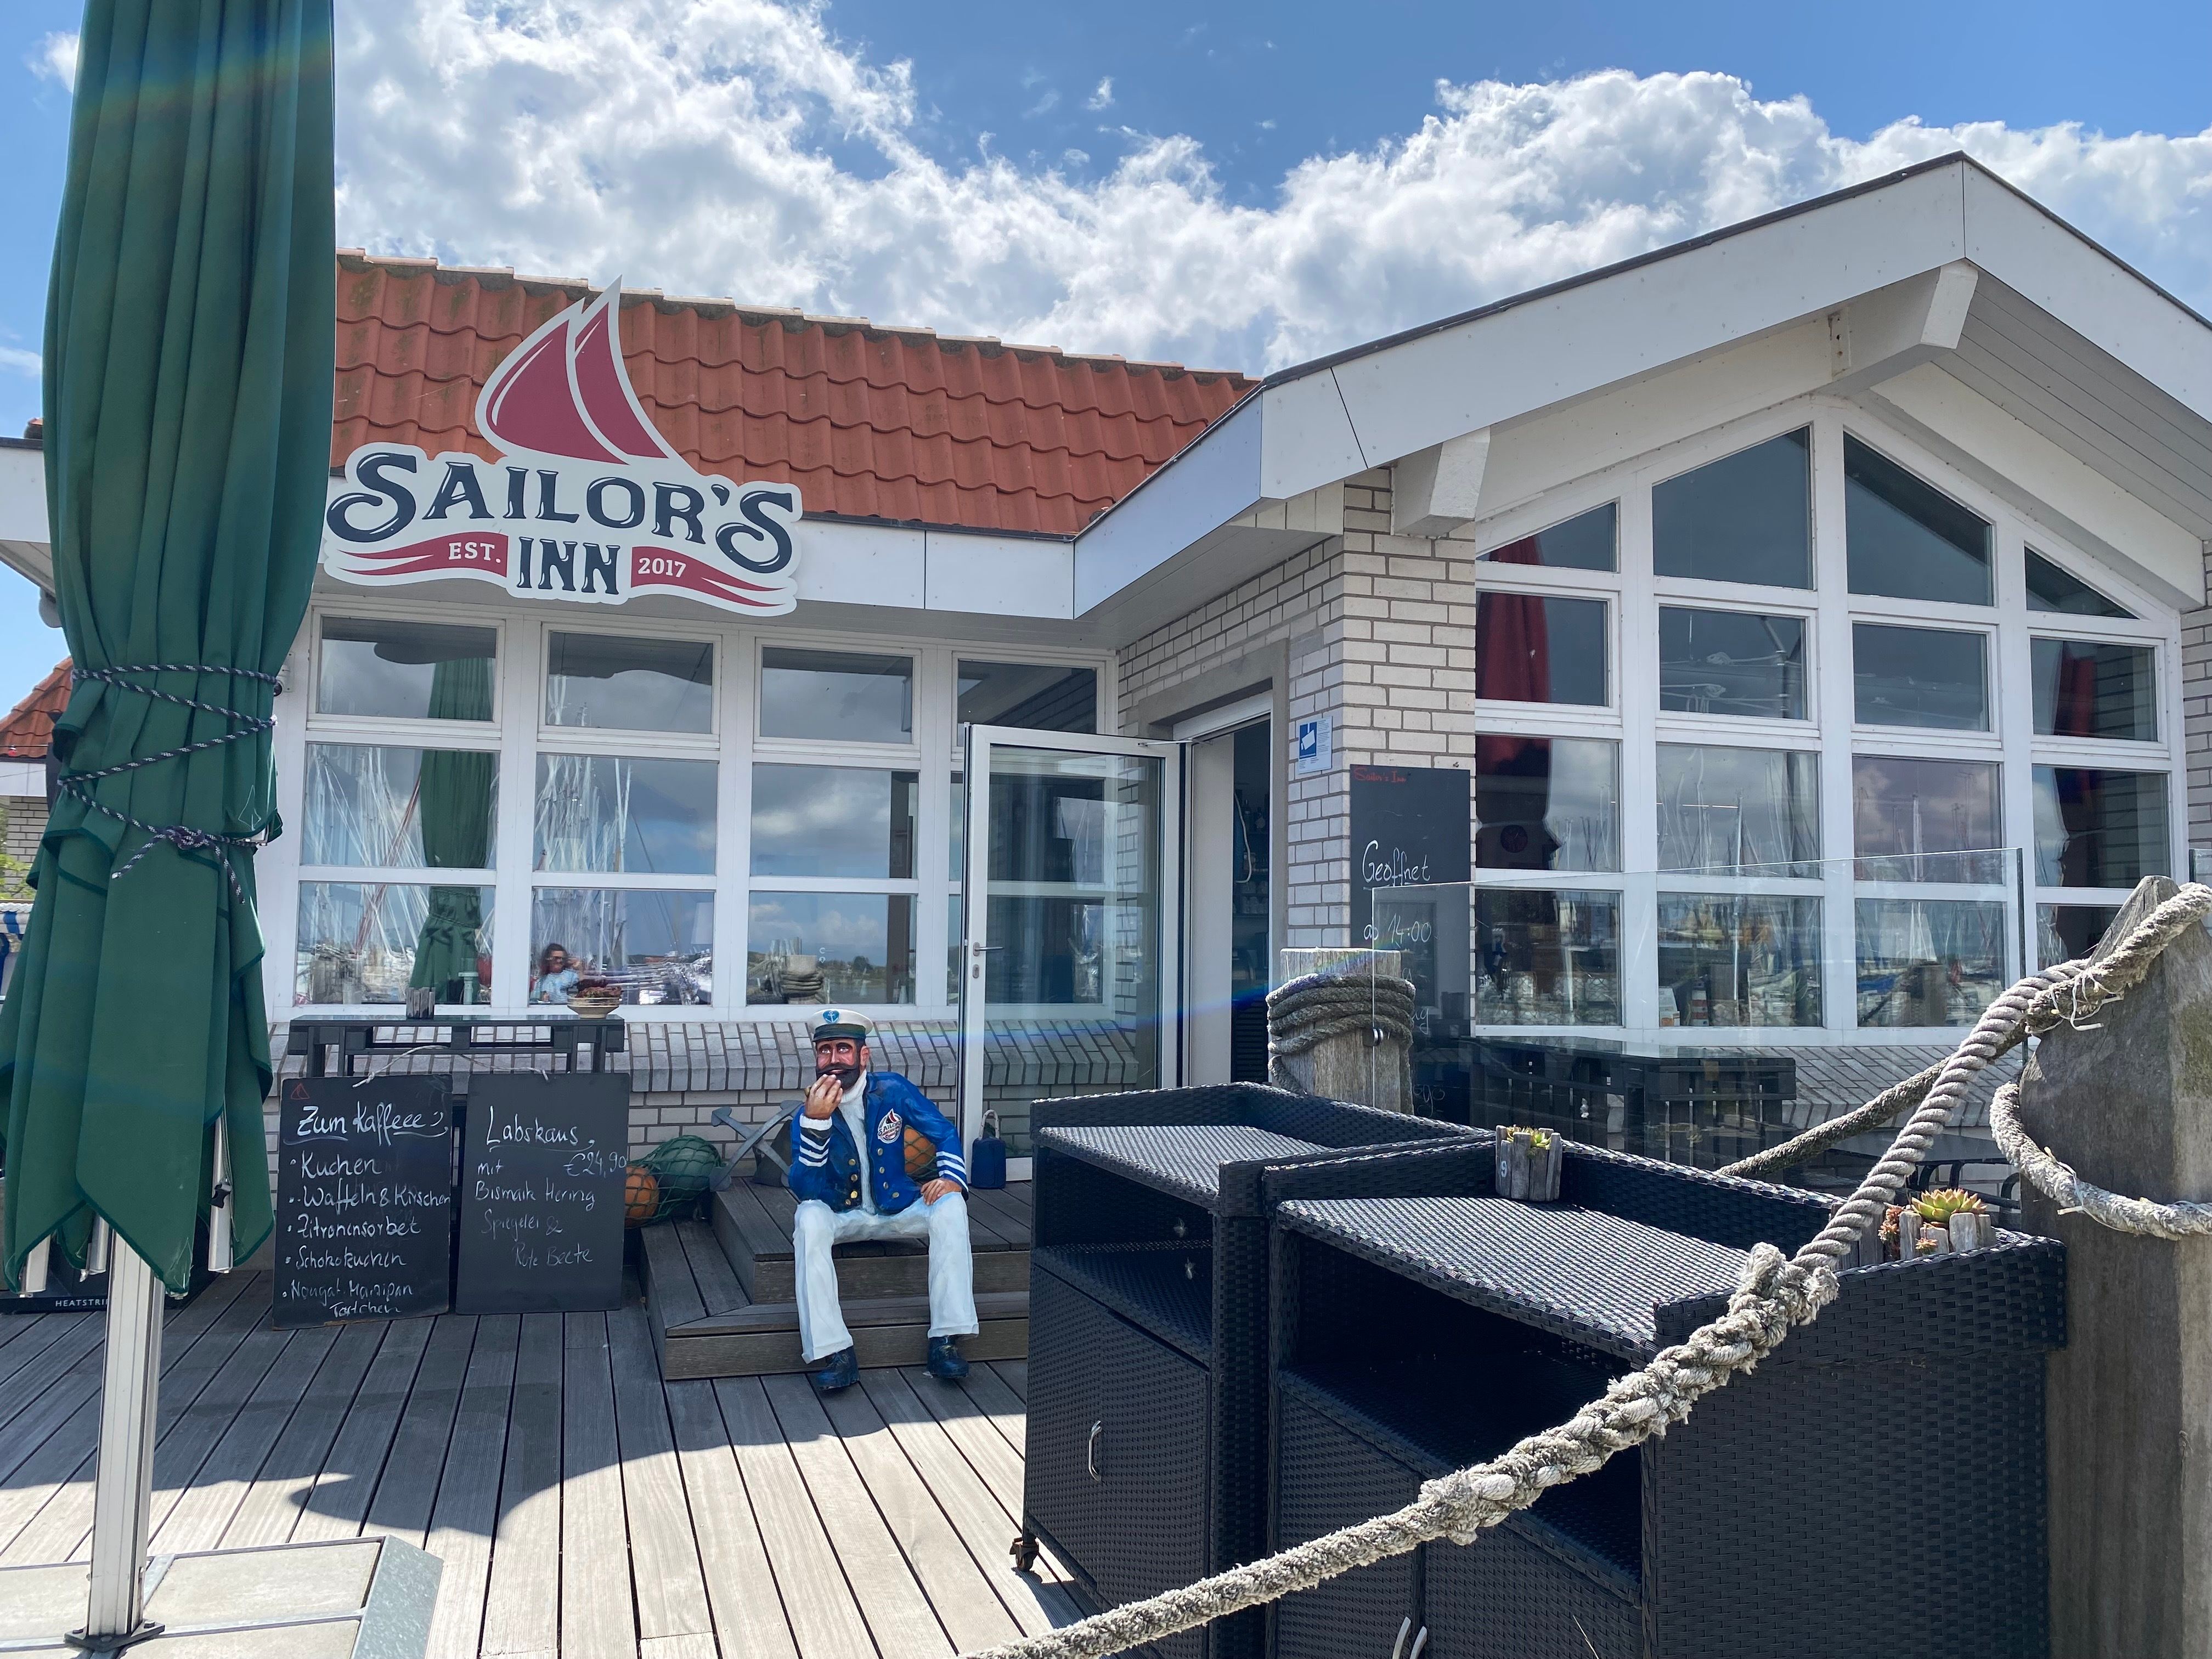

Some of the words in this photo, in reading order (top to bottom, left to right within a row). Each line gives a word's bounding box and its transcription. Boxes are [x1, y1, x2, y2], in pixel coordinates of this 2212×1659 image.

[326, 452, 793, 574] SAILOR'S
[448, 541, 501, 563] EST.
[517, 536, 620, 595] INN
[637, 557, 687, 578] 2017
[1388, 913, 1431, 944] 14:00
[297, 1106, 347, 1136] Zum
[486, 1105, 579, 1146] Labskaus
[302, 1150, 382, 1179] Kuchen
[477, 1159, 504, 1175] mit
[563, 1150, 627, 1178] €24,90
[1500, 1160, 1508, 1177] 9
[303, 1178, 376, 1215] Waffeln
[379, 1188, 391, 1207] &
[394, 1182, 450, 1207] Kirschen
[545, 1177, 595, 1211] Hering
[297, 1213, 421, 1239] Zitronensorbet
[481, 1208, 539, 1242] Spiegelei
[546, 1216, 563, 1235] &
[296, 1245, 407, 1270] Schokokuchen
